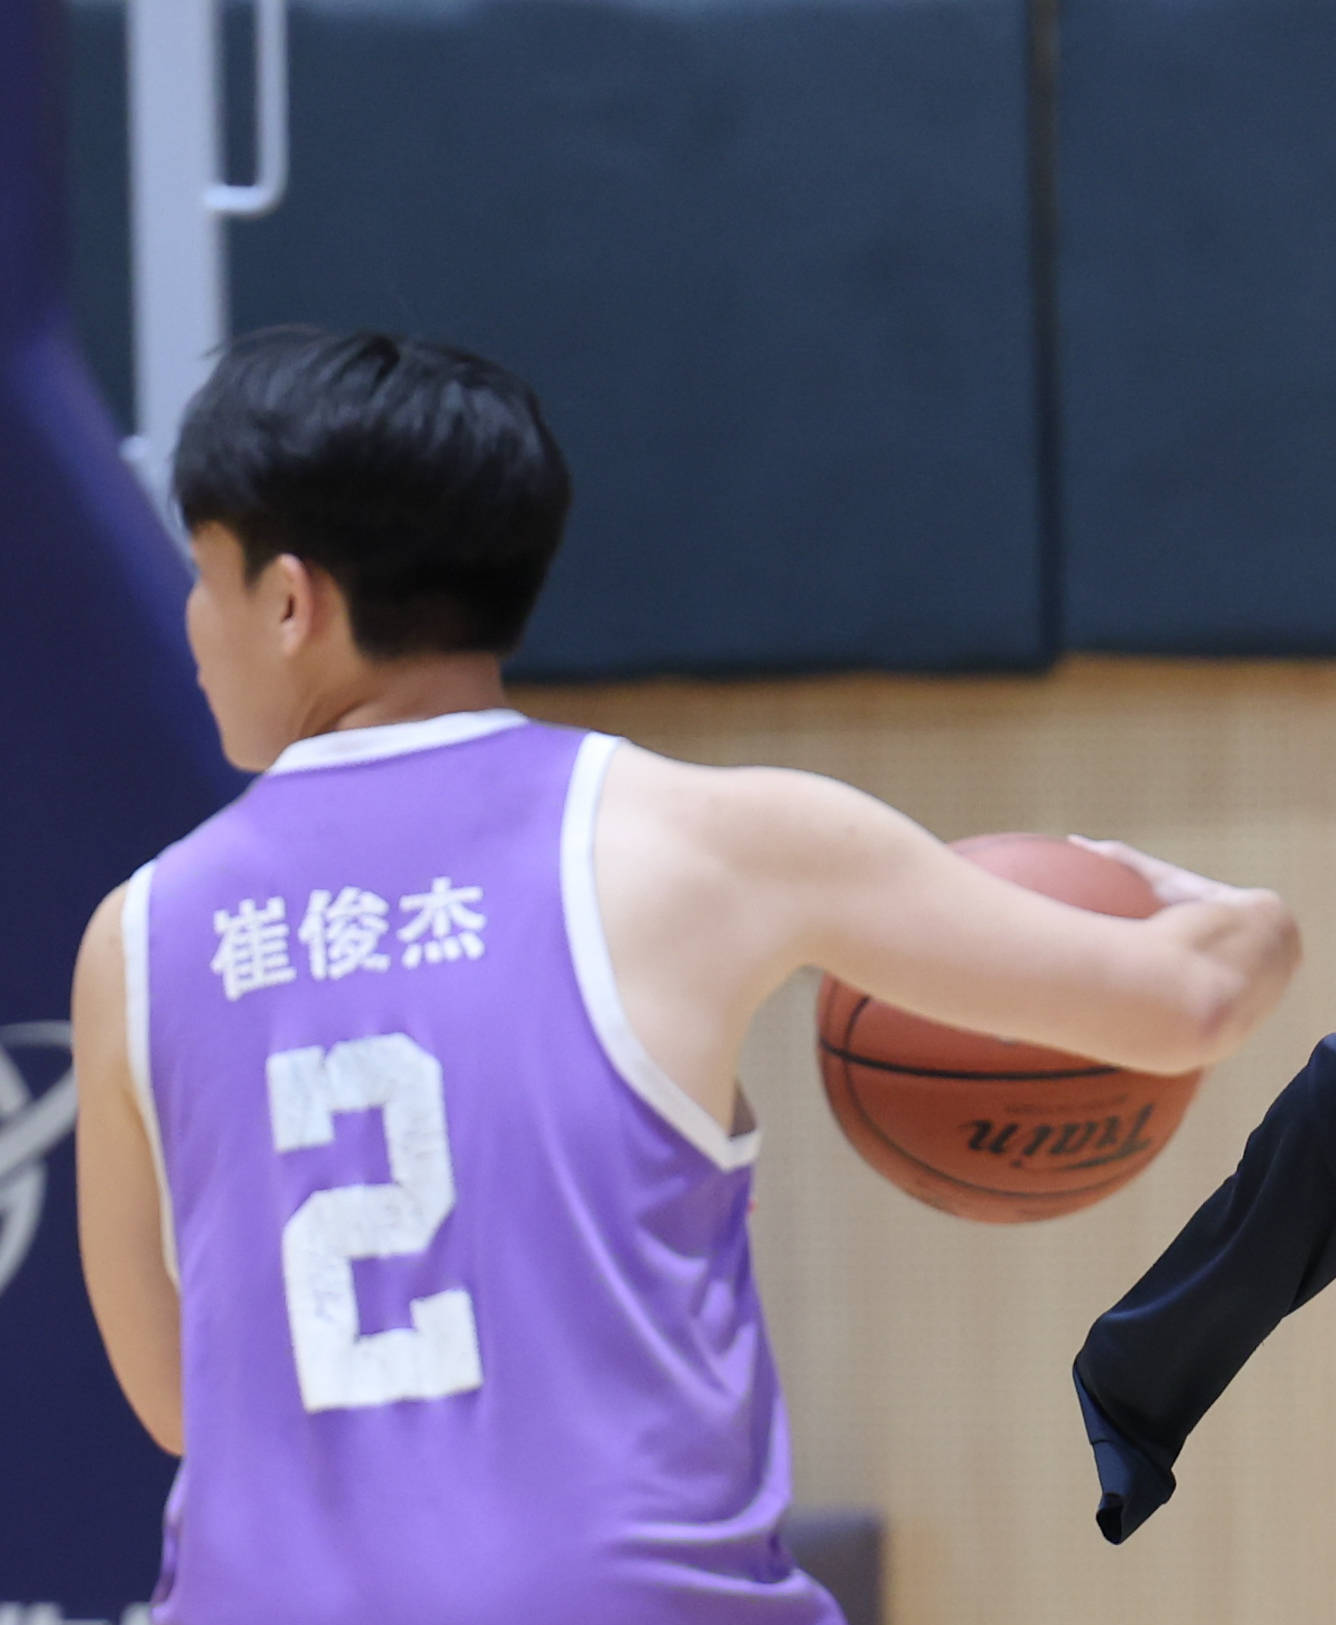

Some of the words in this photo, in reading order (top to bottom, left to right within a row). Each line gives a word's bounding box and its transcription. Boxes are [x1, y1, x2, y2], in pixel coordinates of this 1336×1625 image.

[210, 876, 487, 1002] 崔俊杰
[266, 1032, 483, 1414] 2
